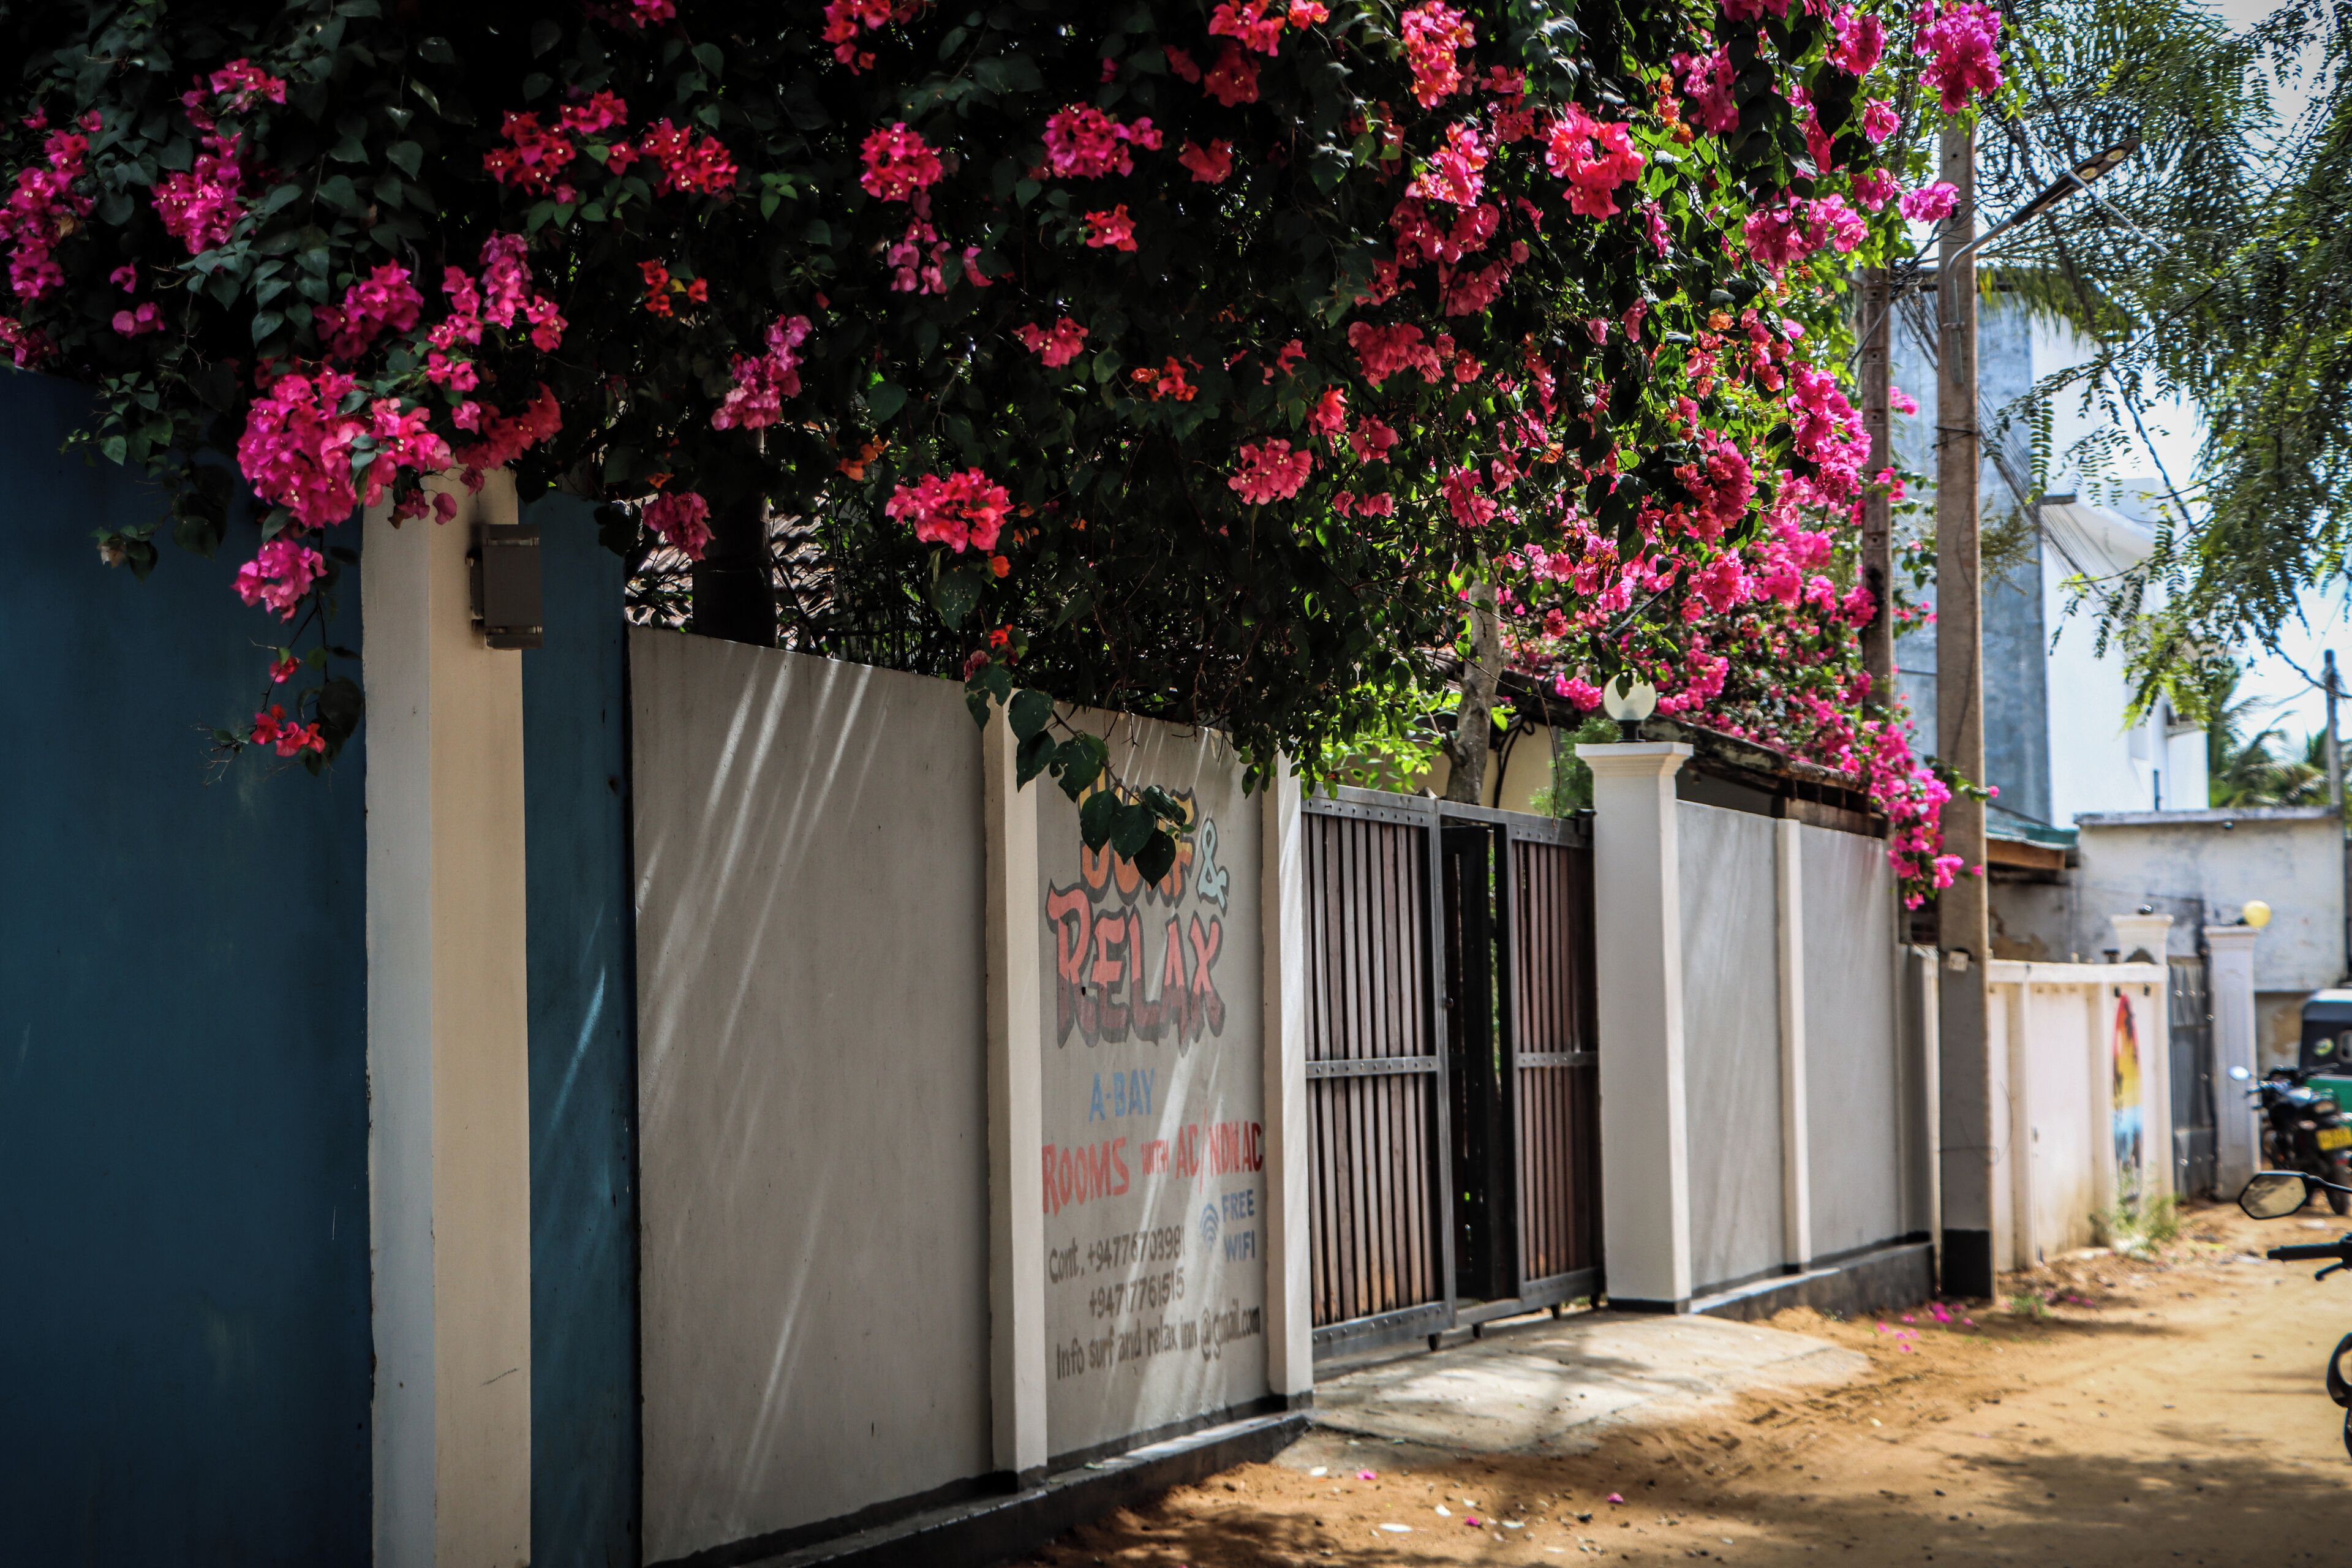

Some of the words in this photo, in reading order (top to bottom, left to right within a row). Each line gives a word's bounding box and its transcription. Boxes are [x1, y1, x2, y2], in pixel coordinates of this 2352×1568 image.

[1196, 817, 1230, 920] &
[1045, 878, 1226, 1057] RELAX
[1041, 1137, 1129, 1216] ROOMS
[1221, 1189, 1255, 1223] FREE
[1224, 1229, 1256, 1264] WIFI
[1089, 1324, 1114, 1369] surf
[1118, 1318, 1141, 1363] and
[1147, 1314, 1178, 1357] relax
